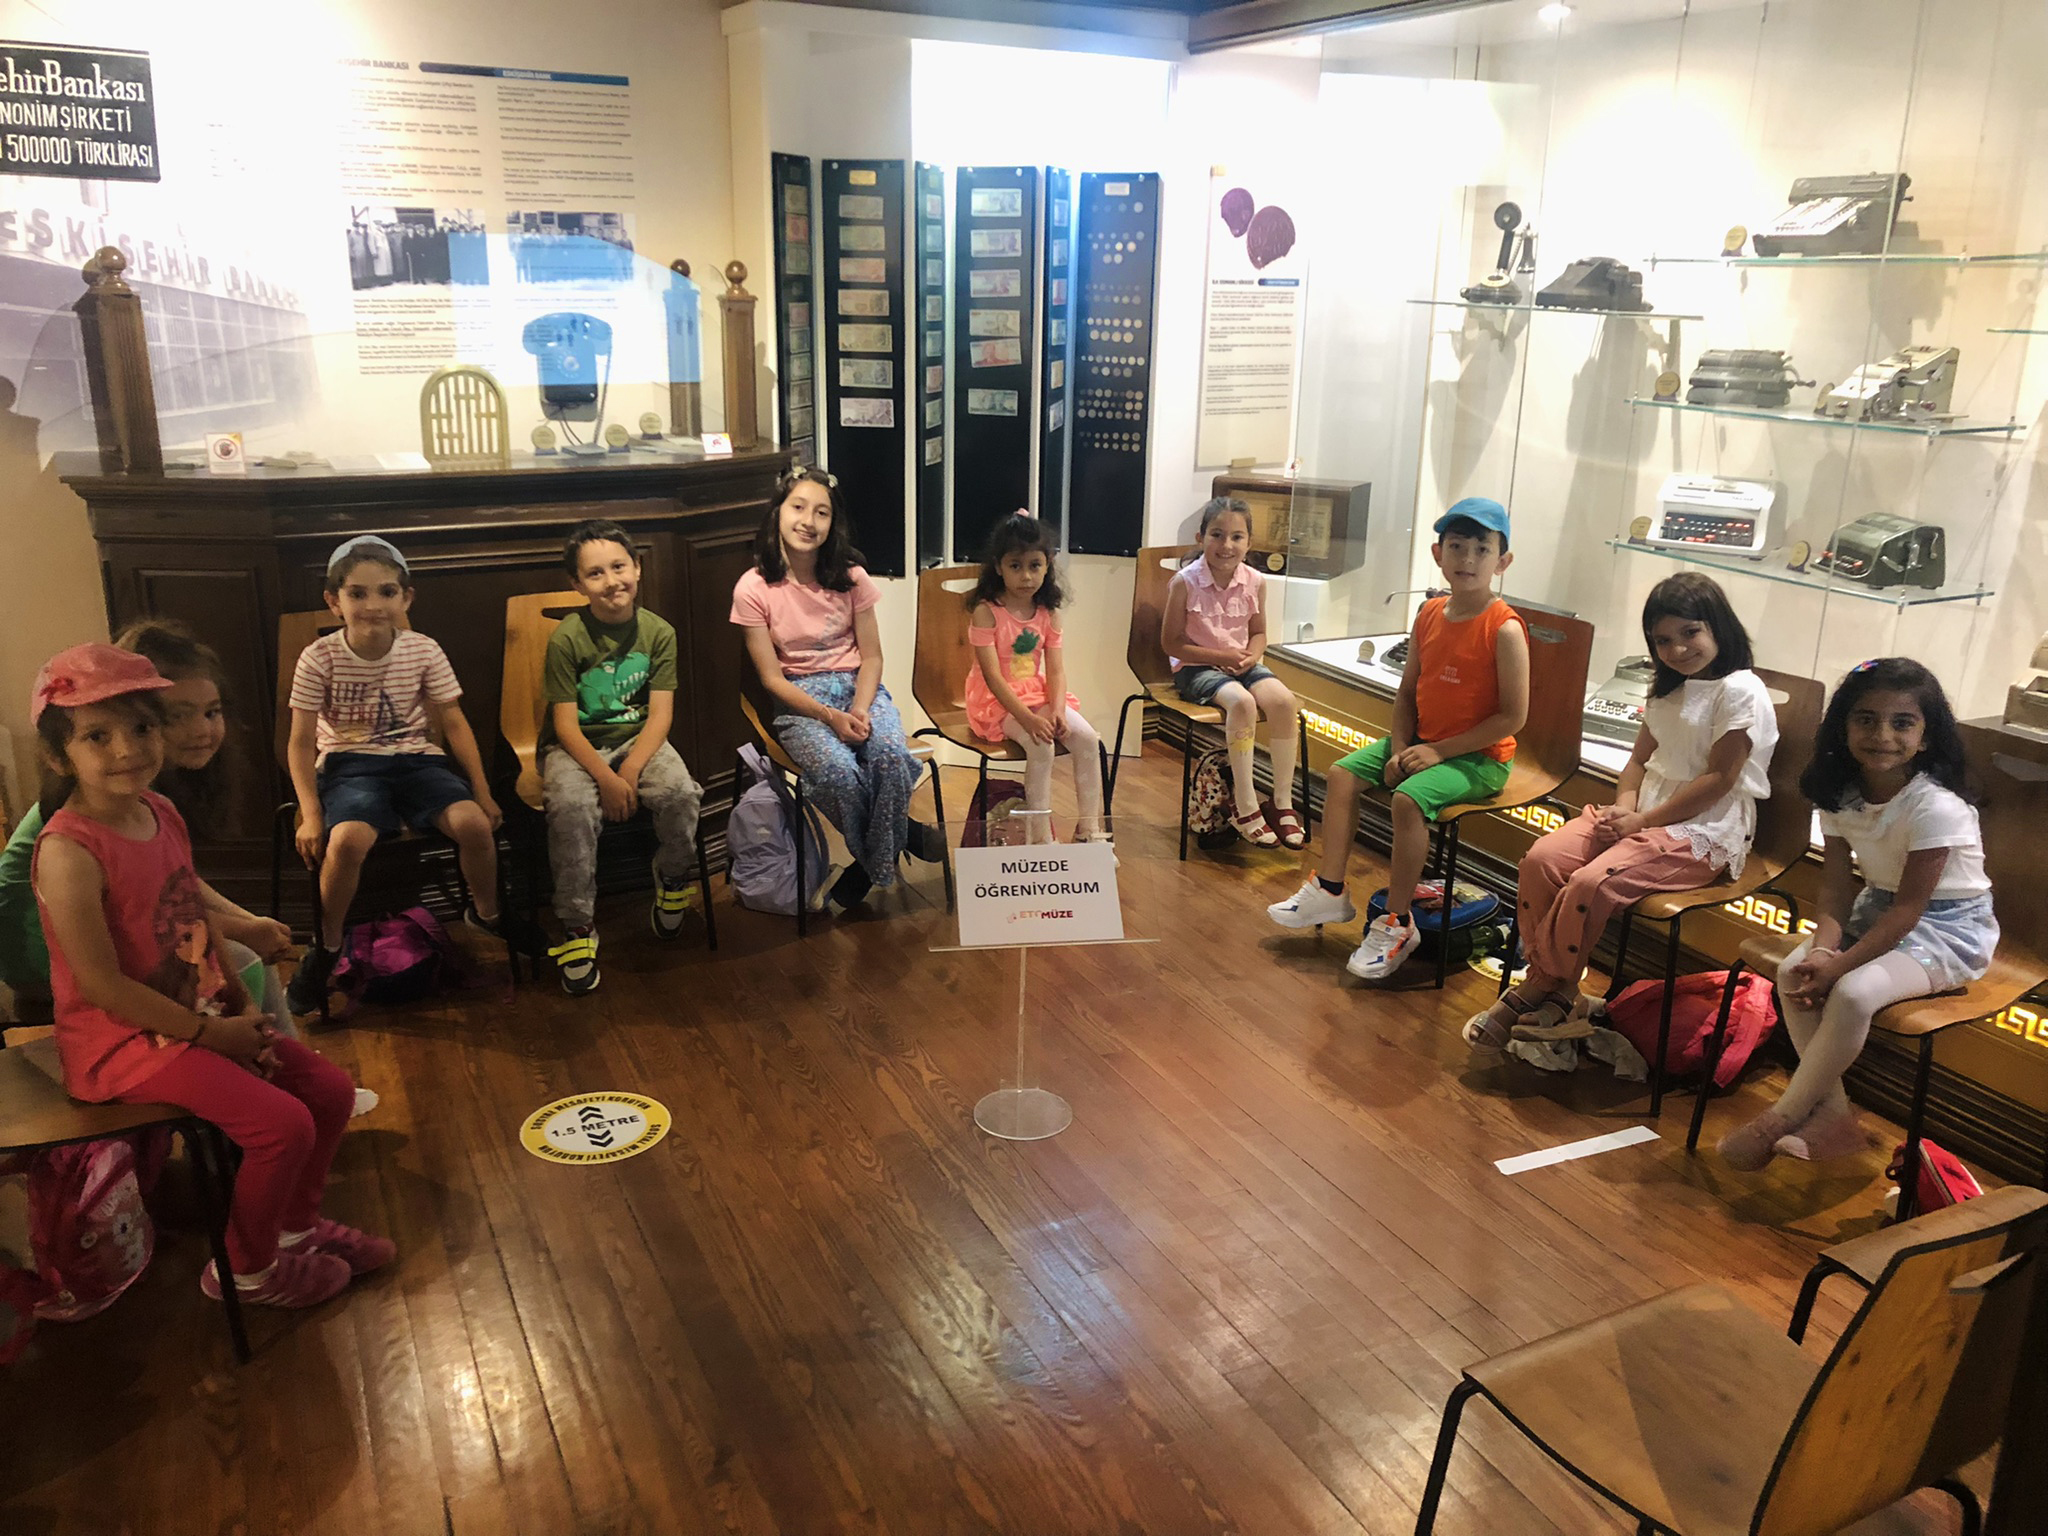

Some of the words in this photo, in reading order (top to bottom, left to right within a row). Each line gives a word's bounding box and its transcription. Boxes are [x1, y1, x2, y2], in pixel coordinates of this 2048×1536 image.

[60, 103, 132, 133] ŞİRKETİ
[7, 134, 72, 165] 500000
[75, 137, 154, 168] TÜRKLİRASI
[1001, 859, 1069, 874] MÜZEDE
[974, 881, 1100, 898] ÖĞRENİYORUM
[551, 1126, 577, 1138] 1.5
[581, 1114, 641, 1133] METRE
